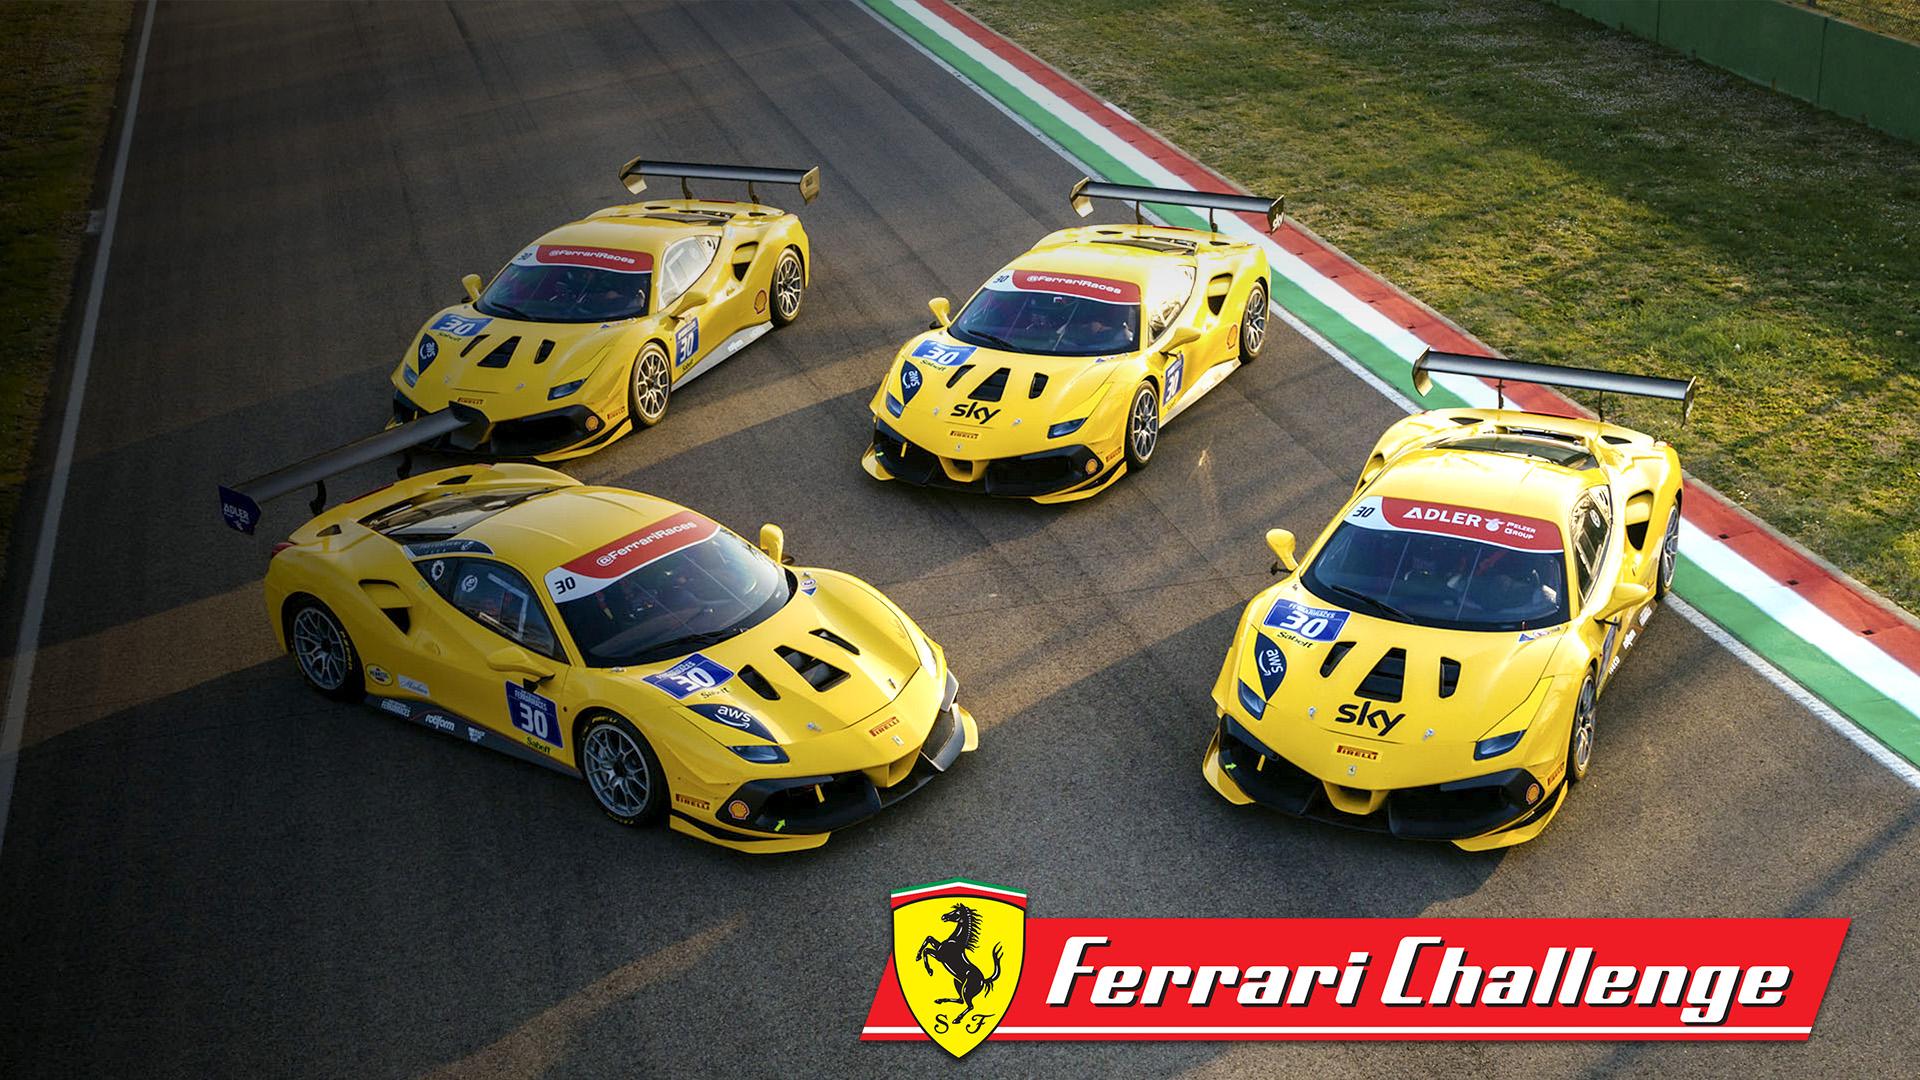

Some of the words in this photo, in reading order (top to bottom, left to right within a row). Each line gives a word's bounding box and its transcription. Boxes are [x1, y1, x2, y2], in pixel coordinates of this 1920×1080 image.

[548, 249, 636, 265] @FerrariRaces
[1026, 275, 1122, 294] @FerrariRaces
[440, 318, 475, 335] 30
[680, 332, 695, 363] 30
[923, 346, 960, 365] 30
[908, 370, 920, 387] aws
[950, 401, 1001, 424] sky
[1352, 506, 1376, 518] 30
[1402, 506, 1483, 528] ADLER
[1504, 527, 1534, 540] GROUP
[1506, 521, 1537, 534] PELZER
[596, 521, 697, 567] @FerrariRaces
[554, 576, 577, 595] 30
[1280, 610, 1329, 638] 30
[1277, 631, 1313, 649] Sabelt
[1266, 648, 1284, 674] aws
[669, 667, 716, 692] 30
[519, 702, 549, 739] 30
[717, 703, 751, 723] aws
[1334, 700, 1407, 737] sky
[869, 716, 900, 737] PIRELLI
[1336, 744, 1379, 760] PIRELLI
[675, 793, 711, 811] PIRELLI
